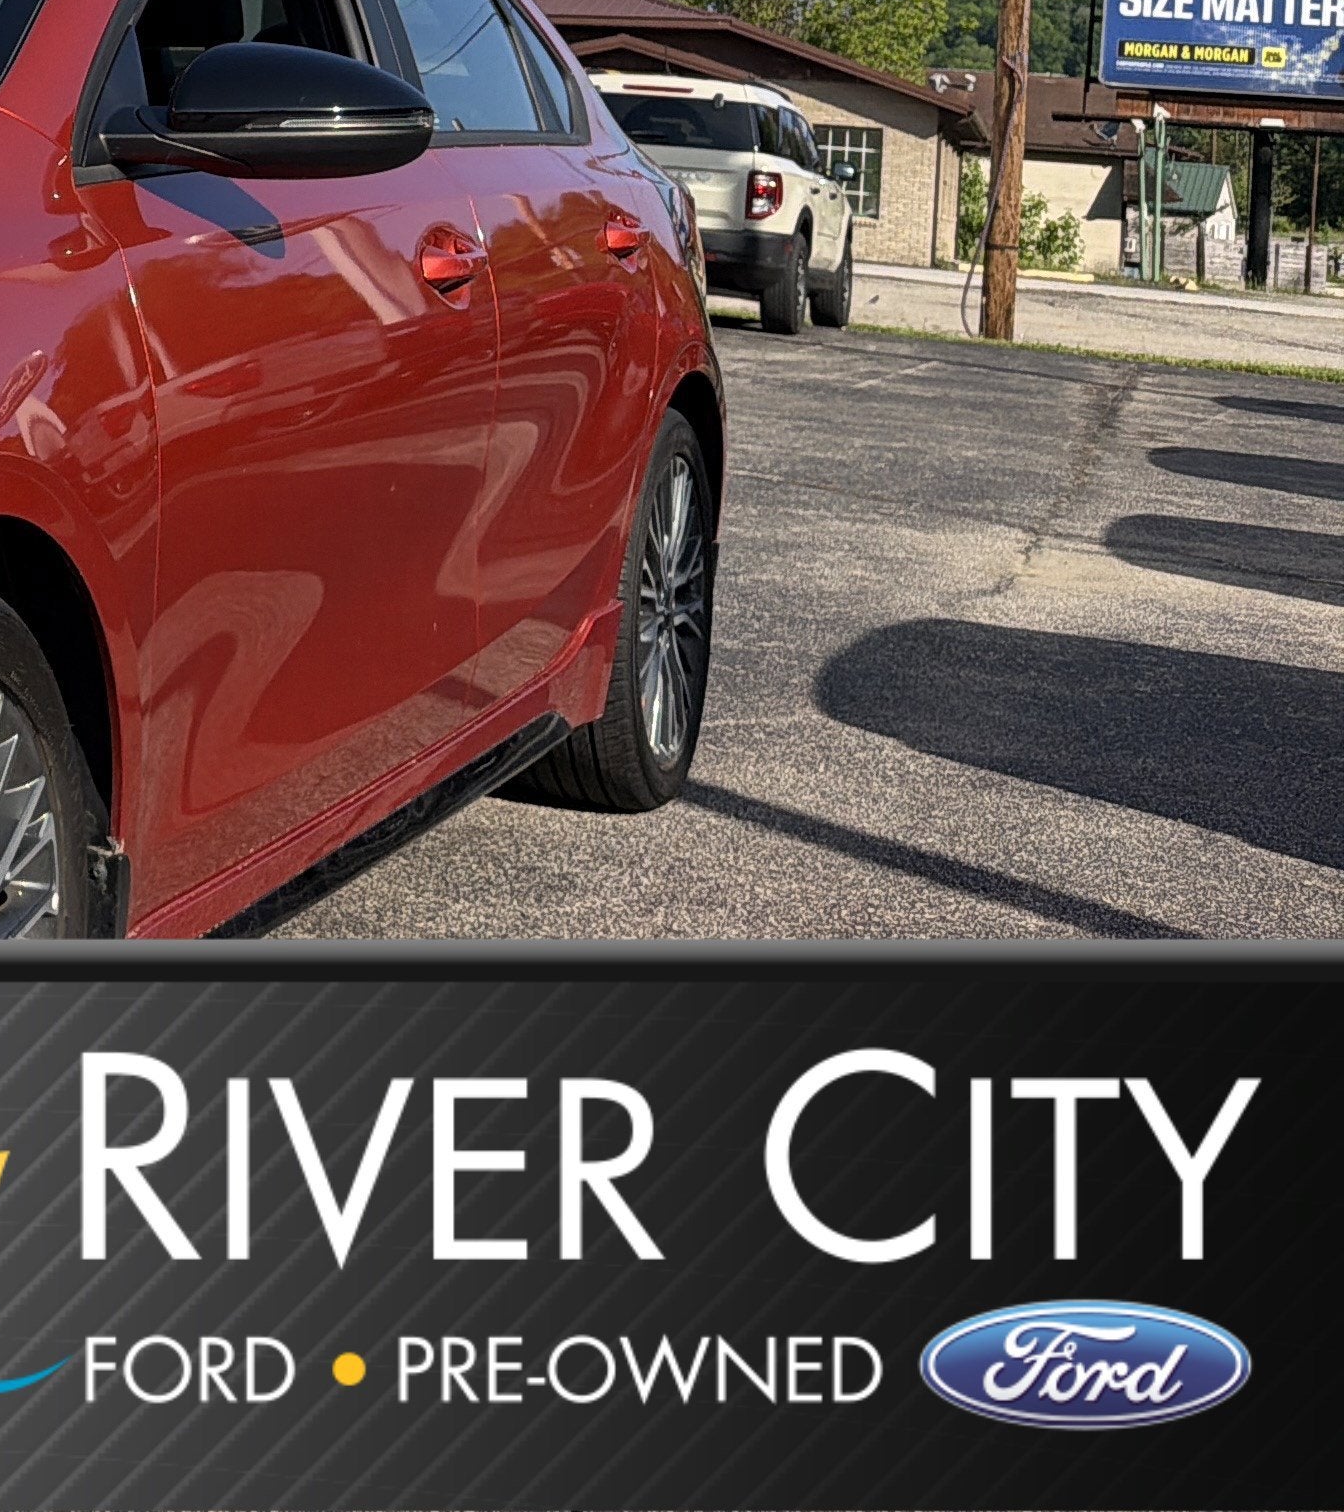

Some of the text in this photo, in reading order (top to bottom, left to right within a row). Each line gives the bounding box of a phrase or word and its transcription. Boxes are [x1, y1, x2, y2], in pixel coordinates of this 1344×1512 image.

[1124, 42, 1179, 60] MORGAN
[1181, 45, 1191, 60] &
[1193, 46, 1250, 63] MORGAN
